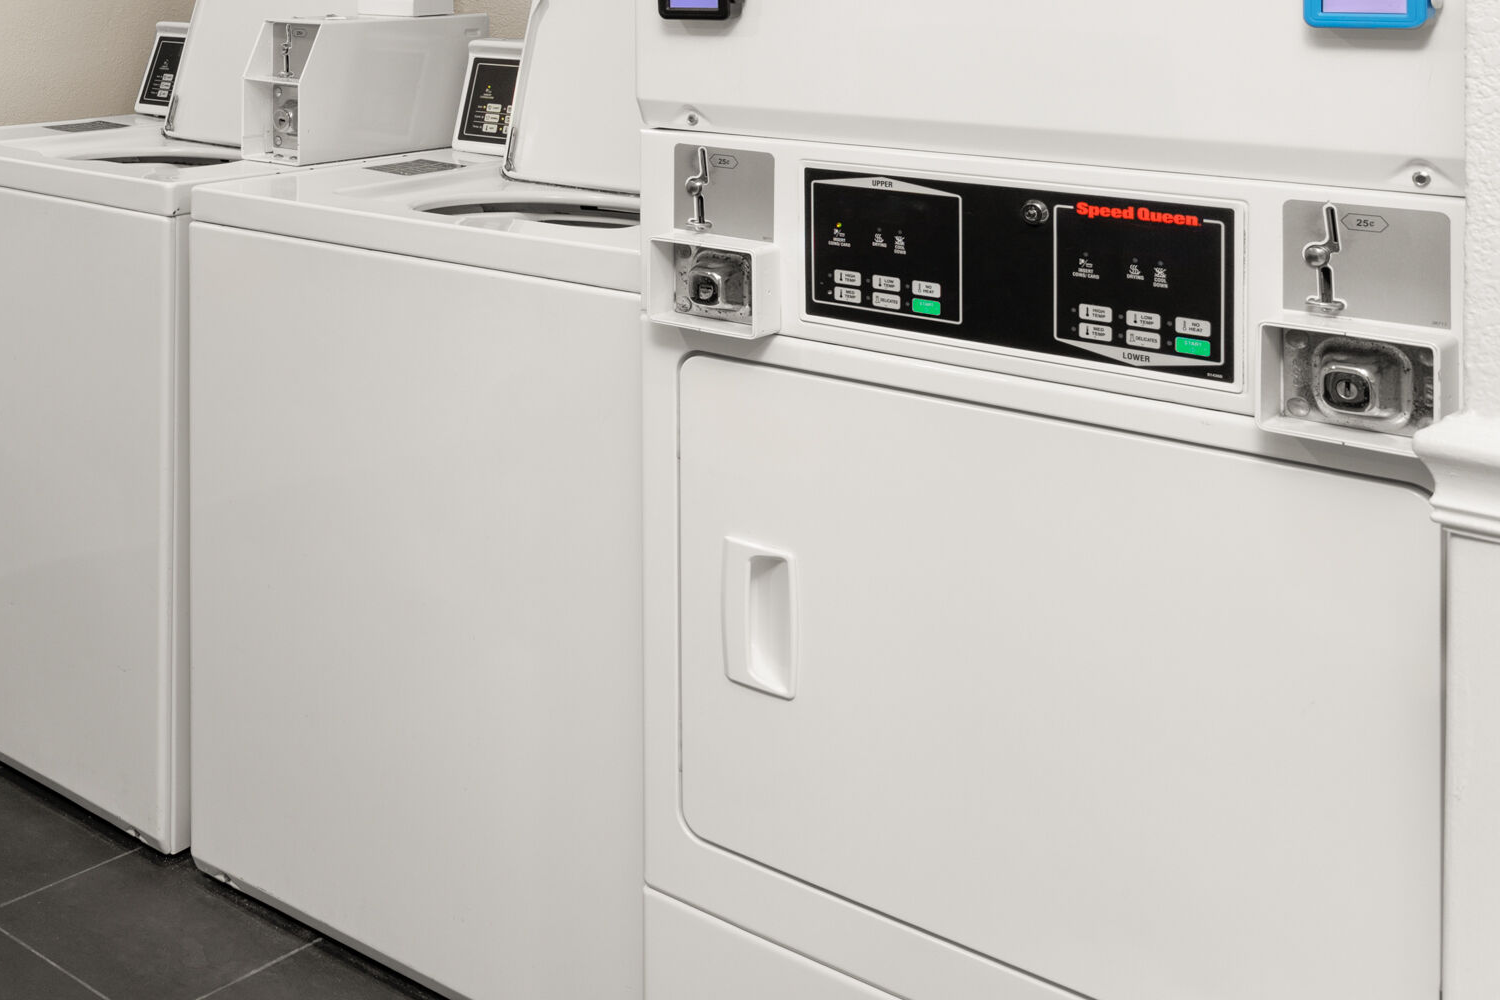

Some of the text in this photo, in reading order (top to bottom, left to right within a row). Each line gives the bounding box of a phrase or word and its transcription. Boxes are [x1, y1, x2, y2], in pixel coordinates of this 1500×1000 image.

[872, 180, 893, 188] UPPER
[1075, 201, 1199, 226] Speed Queen
[1135, 335, 1158, 344] DELICATES
[1122, 351, 1151, 363] LOWER
